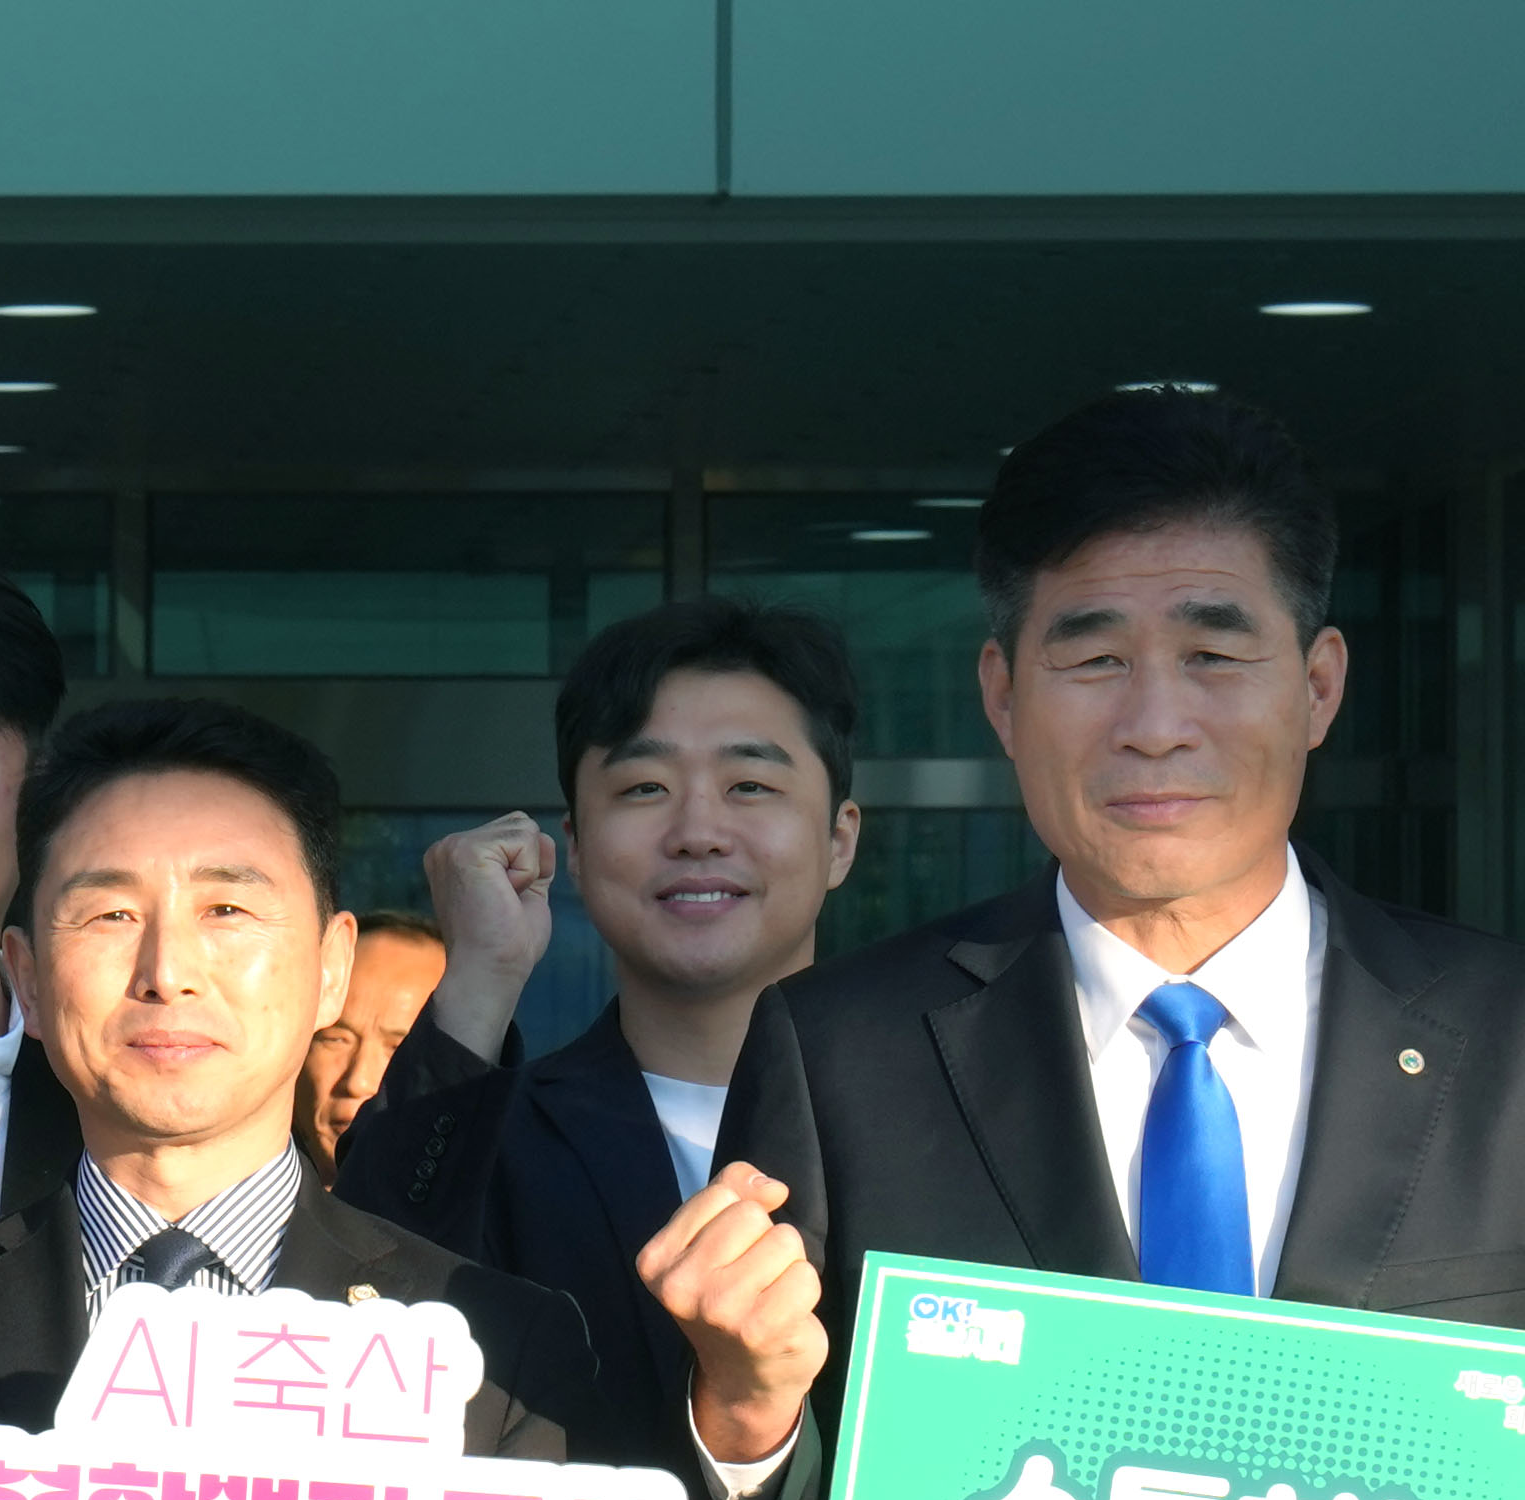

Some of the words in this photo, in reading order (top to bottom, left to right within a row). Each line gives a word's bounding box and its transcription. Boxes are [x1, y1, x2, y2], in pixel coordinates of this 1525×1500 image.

[913, 1297, 972, 1324] OK!
[91, 1318, 198, 1428] AI
[233, 1322, 448, 1444] 축산
